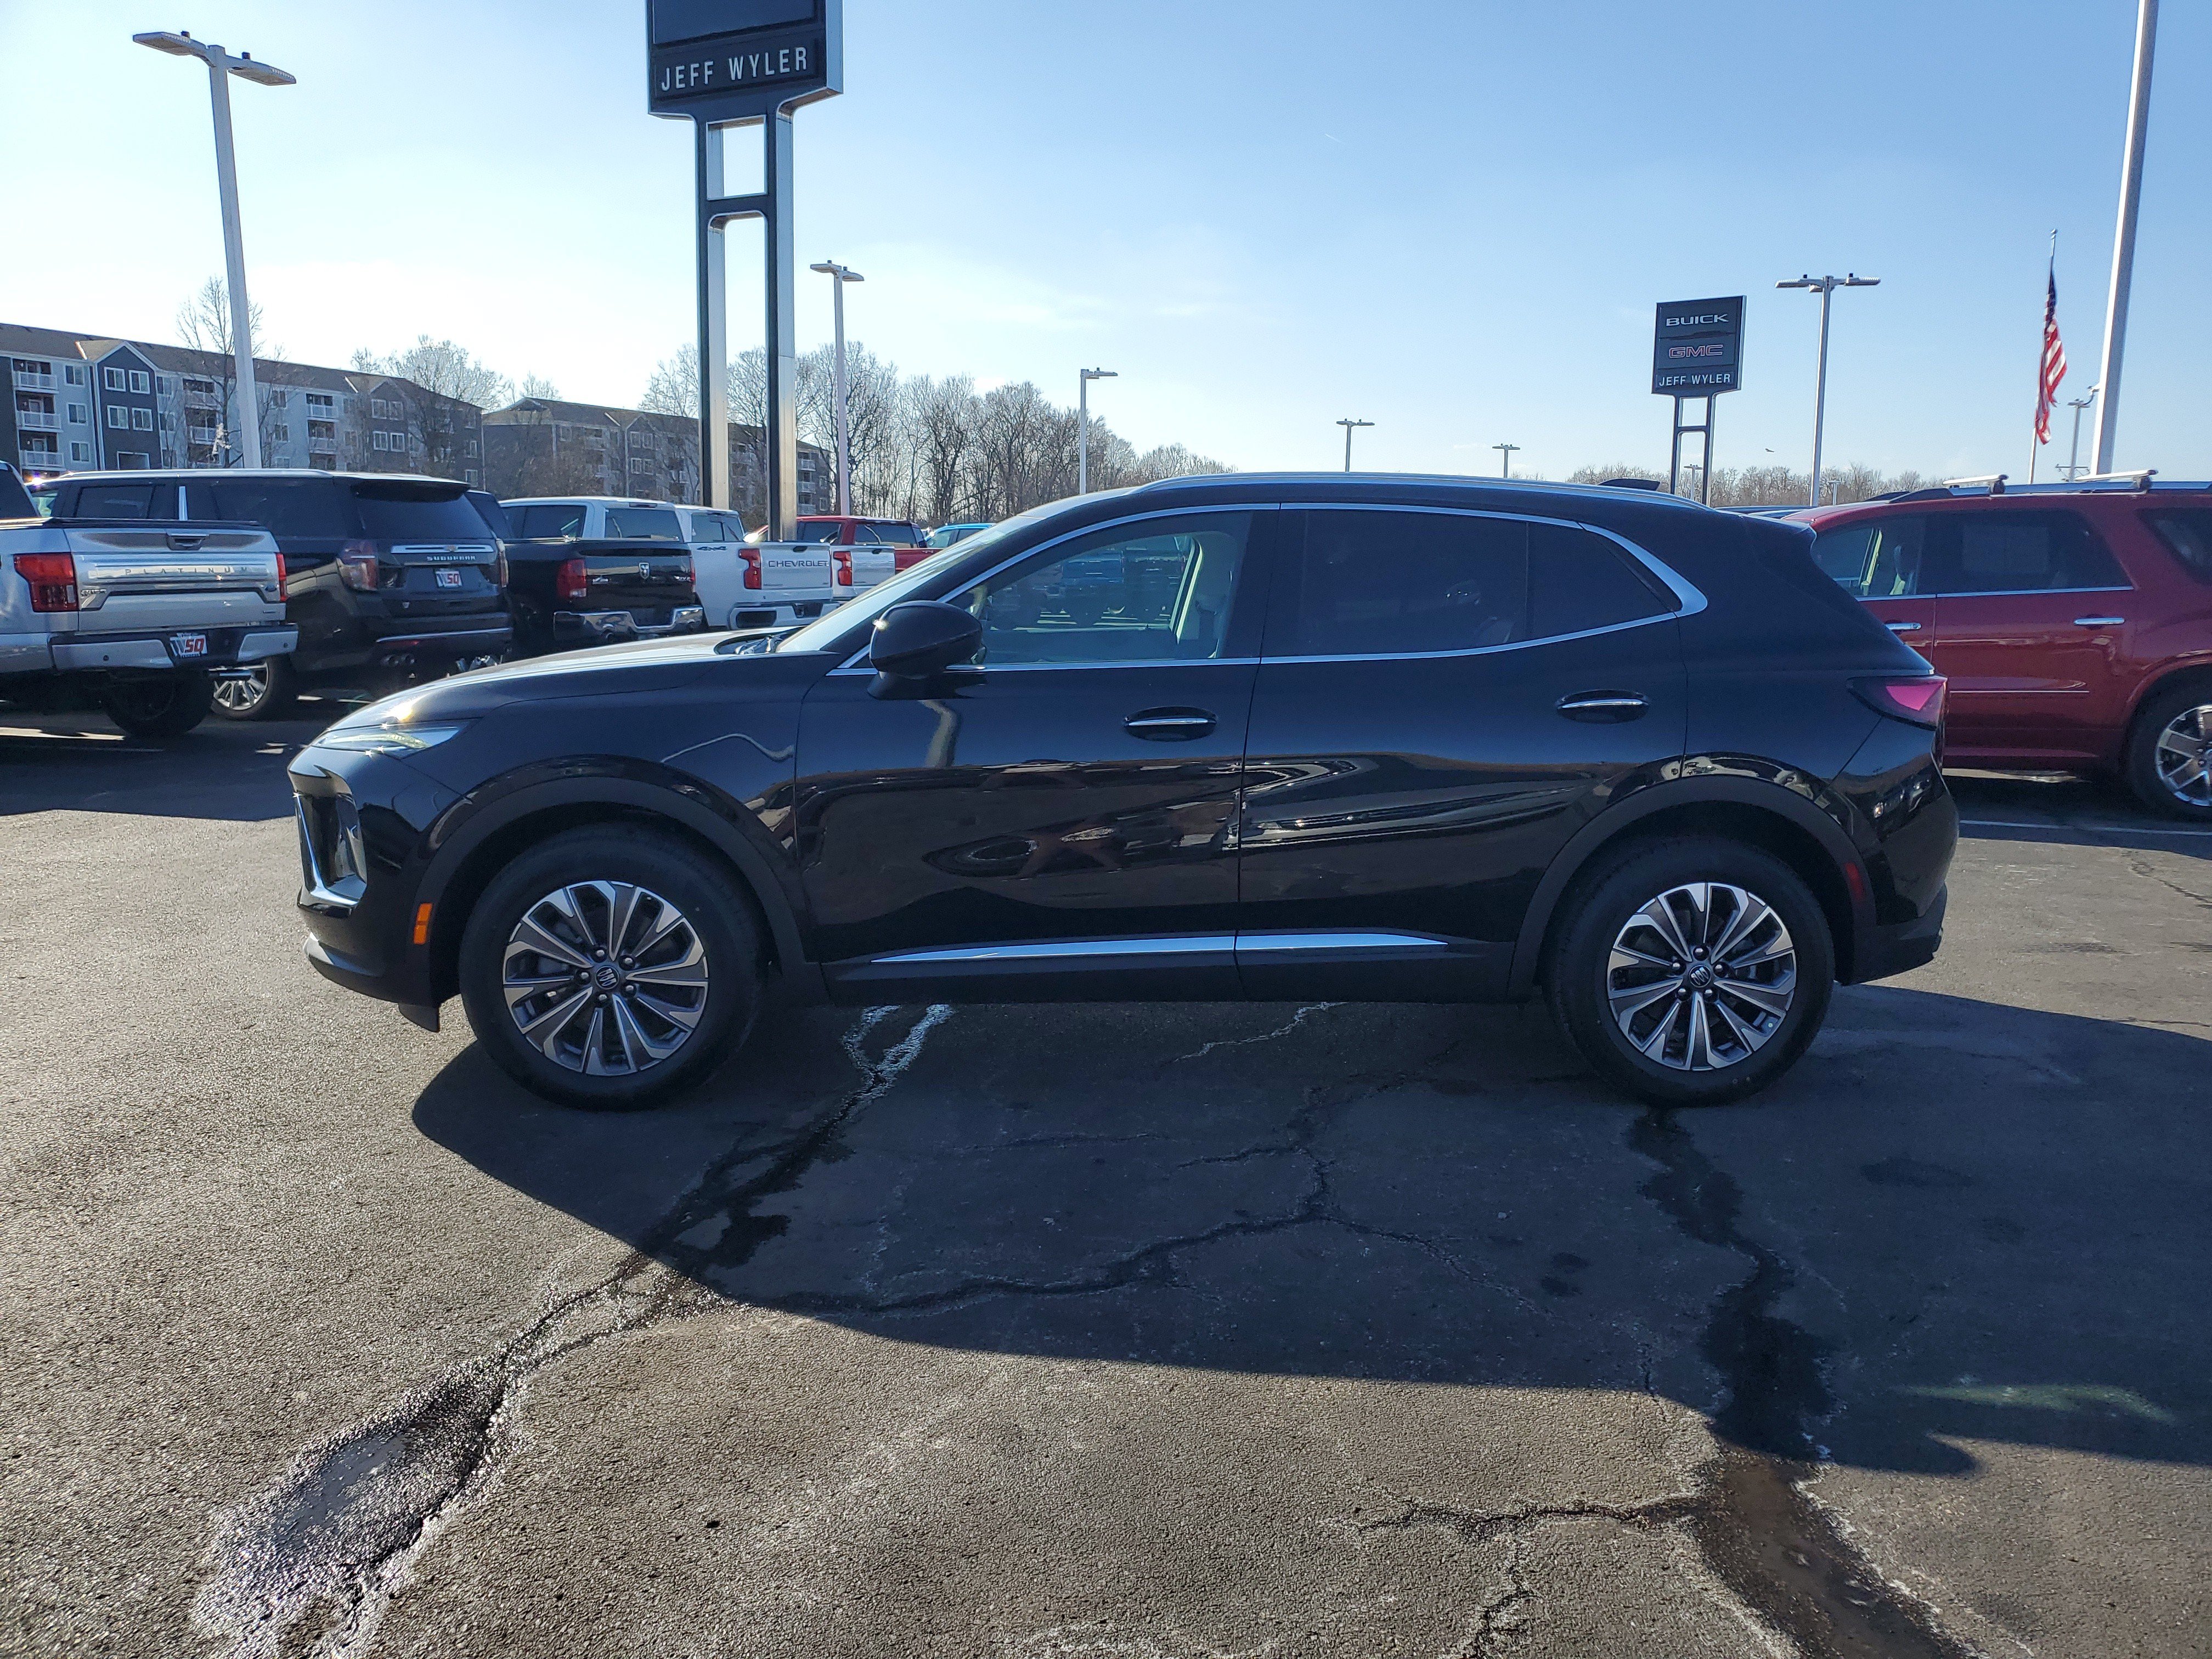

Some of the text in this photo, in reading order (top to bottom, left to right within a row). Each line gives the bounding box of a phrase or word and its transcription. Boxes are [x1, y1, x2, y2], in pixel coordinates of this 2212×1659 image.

[662, 47, 807, 92] JEFF WYLER
[1666, 313, 1729, 326] BUICK
[1668, 345, 1723, 358] GMC
[1659, 374, 1731, 386] JEFF WYLER
